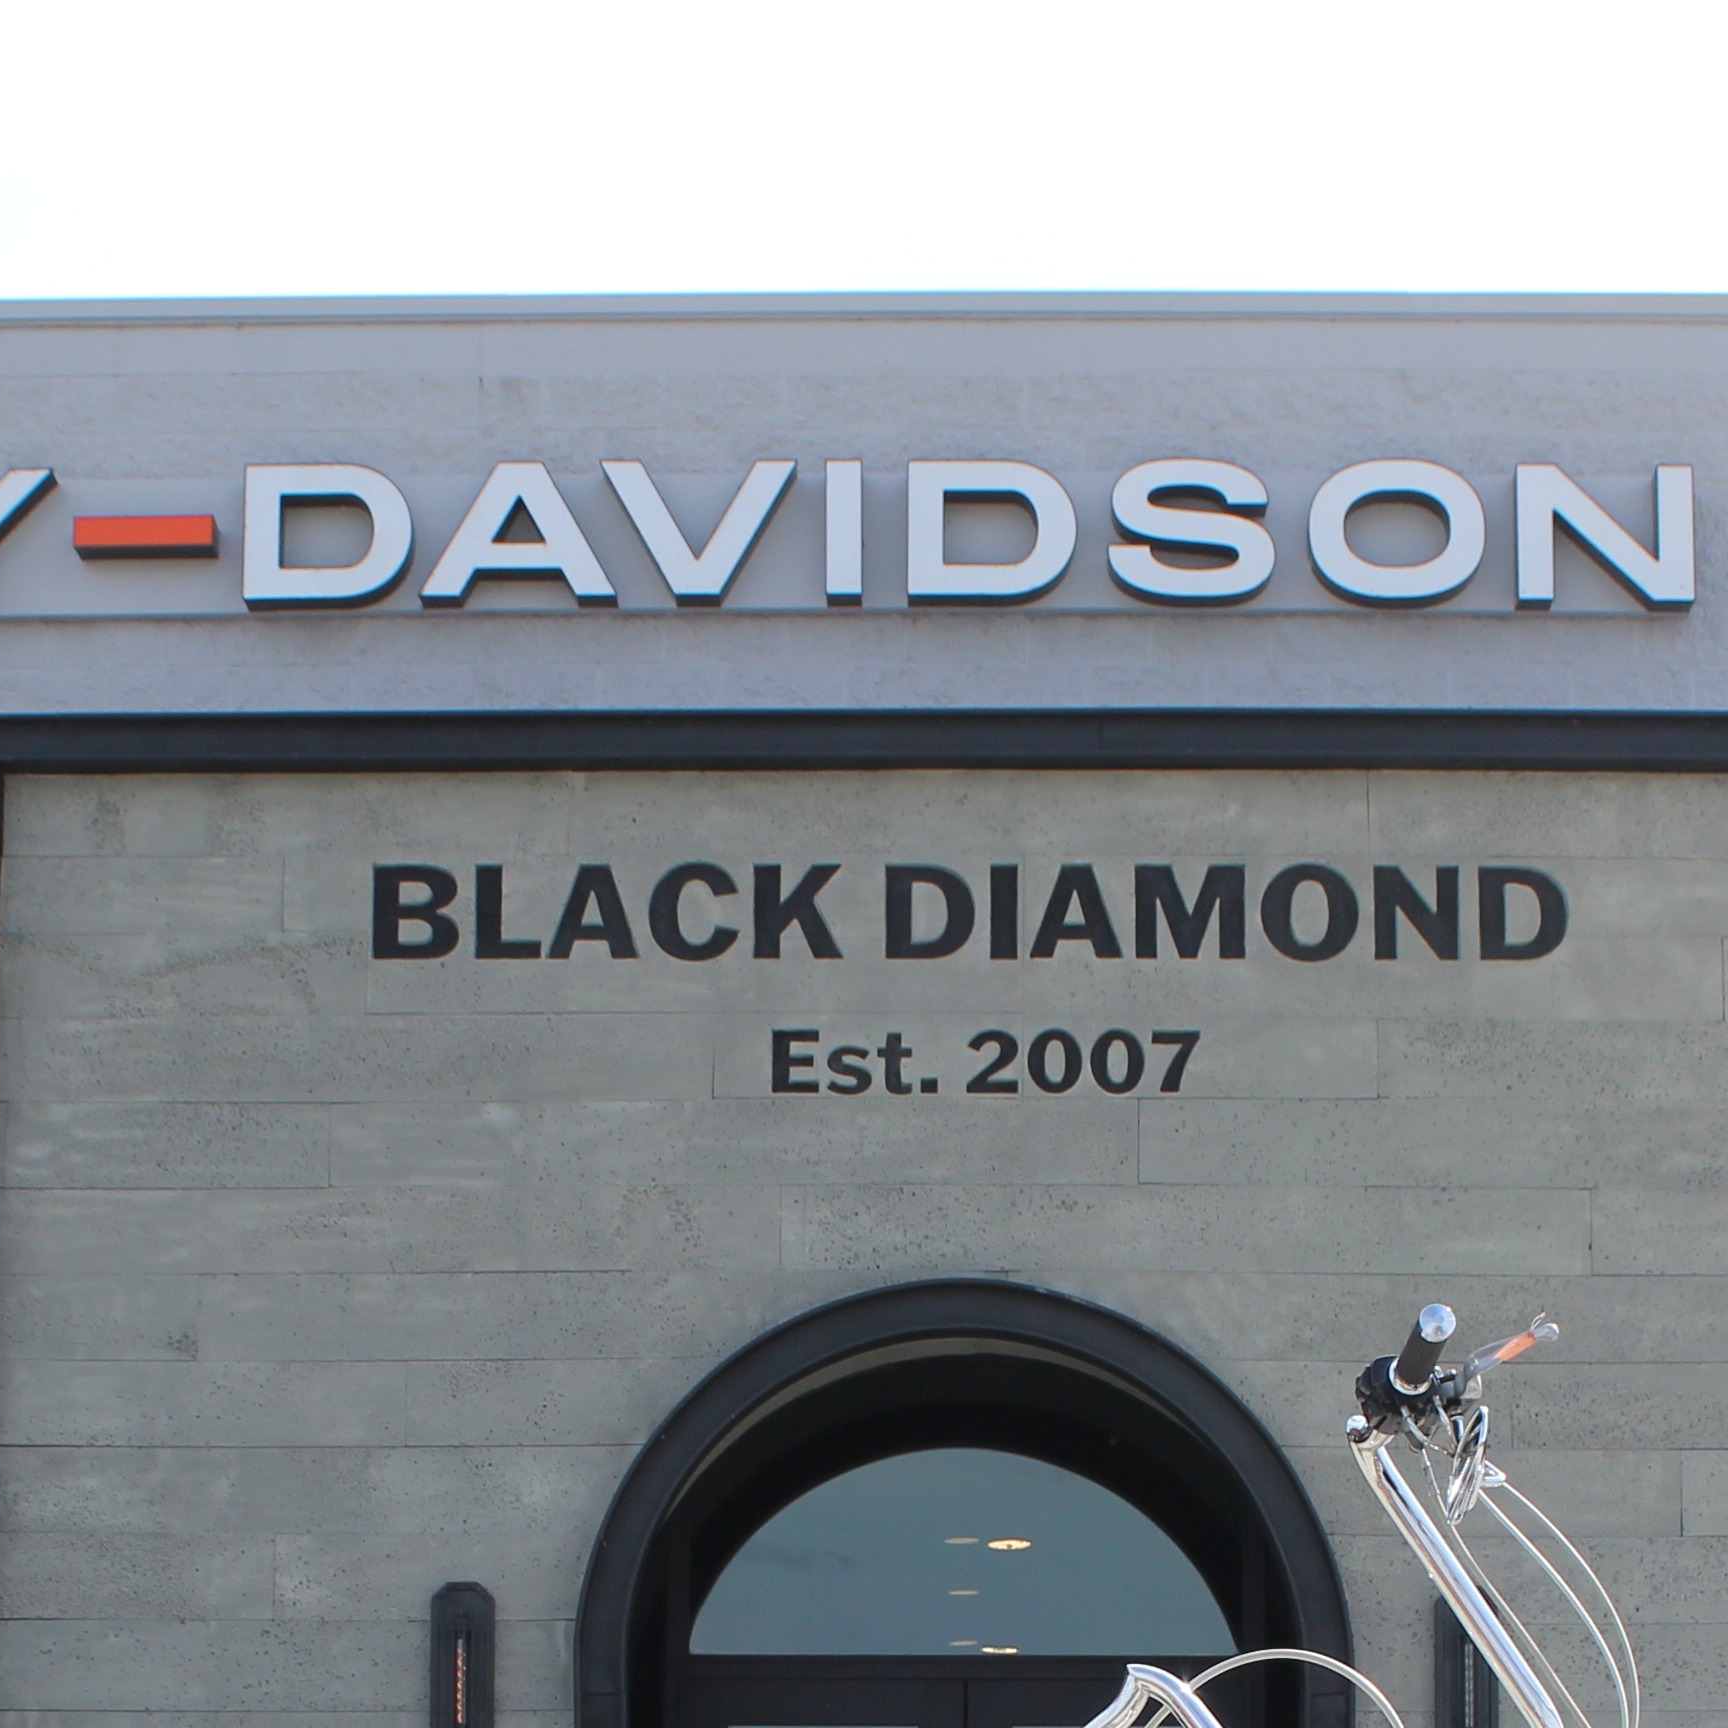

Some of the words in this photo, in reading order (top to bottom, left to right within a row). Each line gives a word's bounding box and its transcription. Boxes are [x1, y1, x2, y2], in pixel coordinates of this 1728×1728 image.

[371, 860, 844, 962] BLACK
[884, 861, 1569, 963] DIAMOND
[771, 1027, 940, 1096] Est.
[965, 1027, 1202, 1096] 2007
